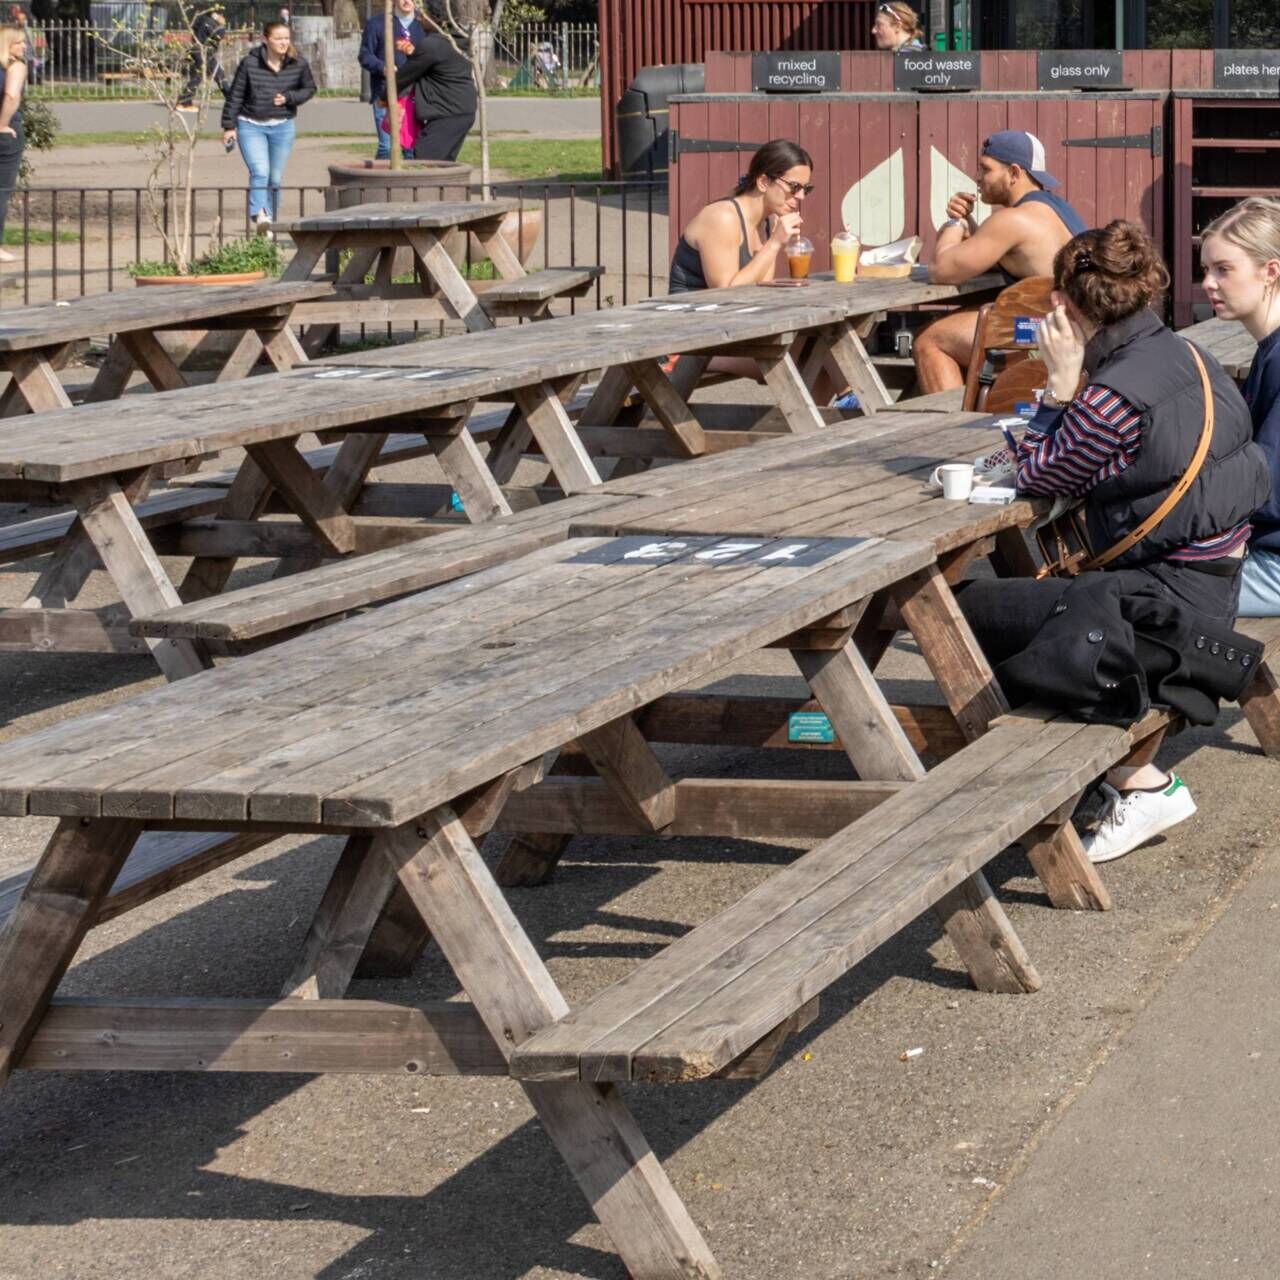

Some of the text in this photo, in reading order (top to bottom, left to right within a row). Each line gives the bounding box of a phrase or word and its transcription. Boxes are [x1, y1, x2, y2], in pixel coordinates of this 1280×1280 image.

[777, 58, 817, 70] mixed
[904, 58, 972, 70] food waste
[1223, 63, 1260, 77] plates
[1050, 64, 1110, 78] glass only
[768, 72, 825, 85] recycling
[924, 72, 951, 85] only
